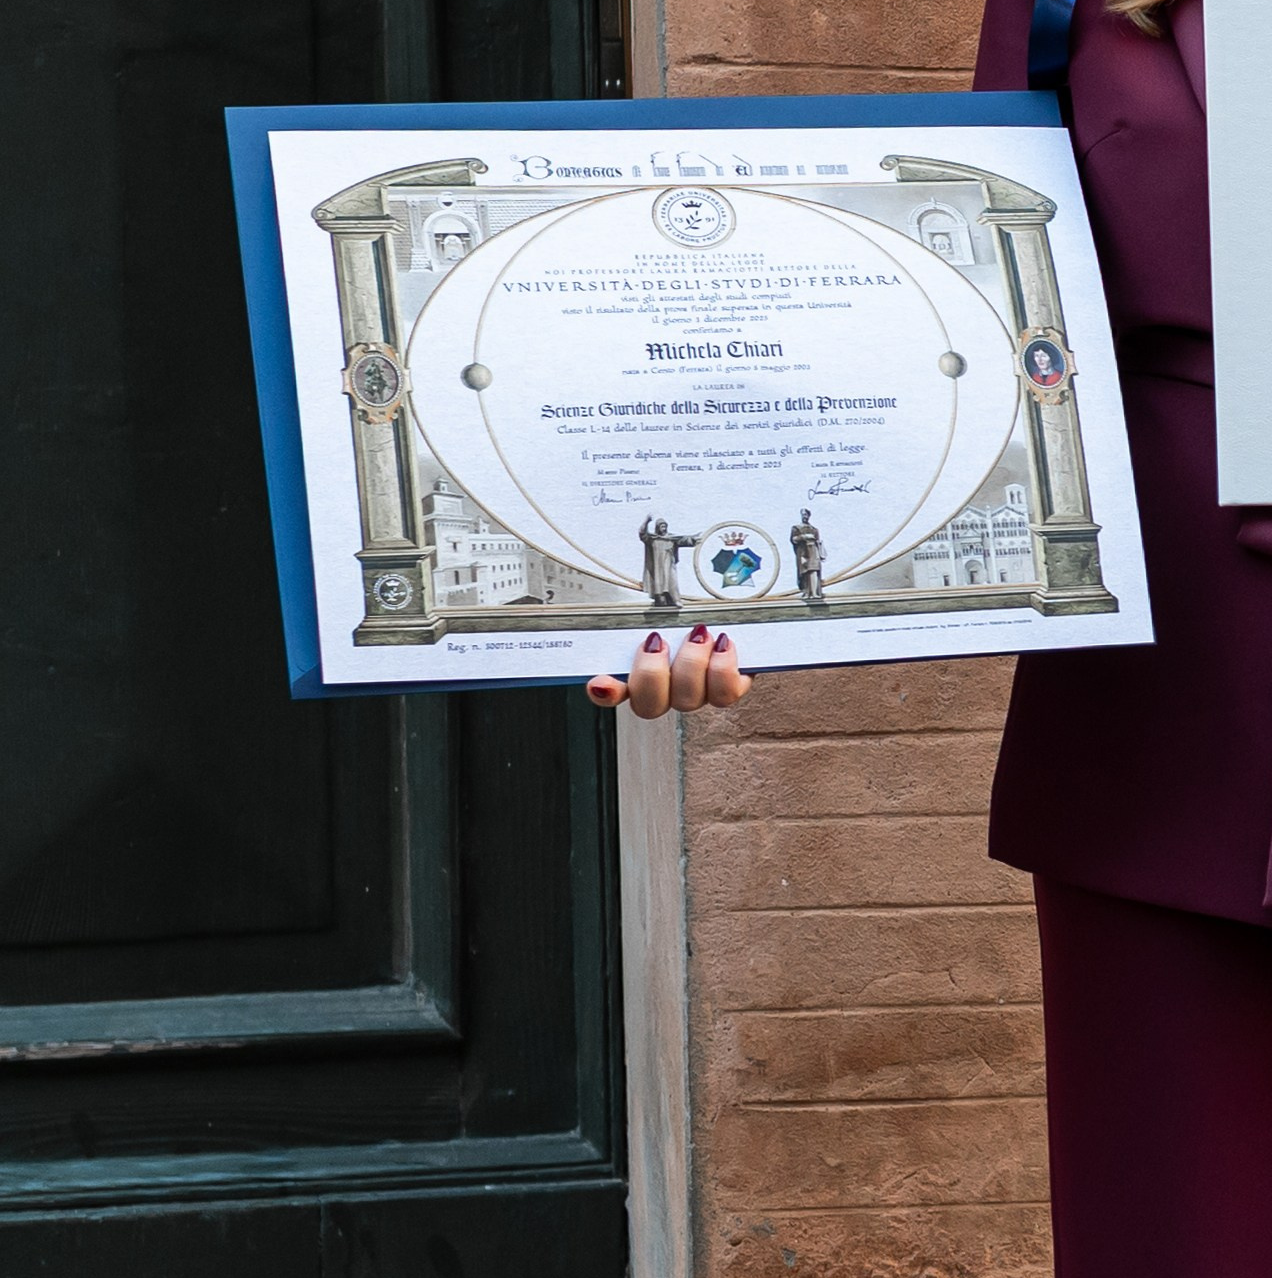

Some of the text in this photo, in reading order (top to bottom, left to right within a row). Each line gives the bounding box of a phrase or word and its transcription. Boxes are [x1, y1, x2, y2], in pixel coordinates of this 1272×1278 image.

[645, 340, 783, 361] Michela Chiari
[541, 395, 897, 419] Scienze Giuridiche della Sicurezza e della Prevenzione
[557, 424, 587, 434] Classe
[614, 422, 637, 433] delle
[686, 422, 721, 432] Scienze
[592, 453, 631, 463] presente
[634, 449, 672, 461] diploma
